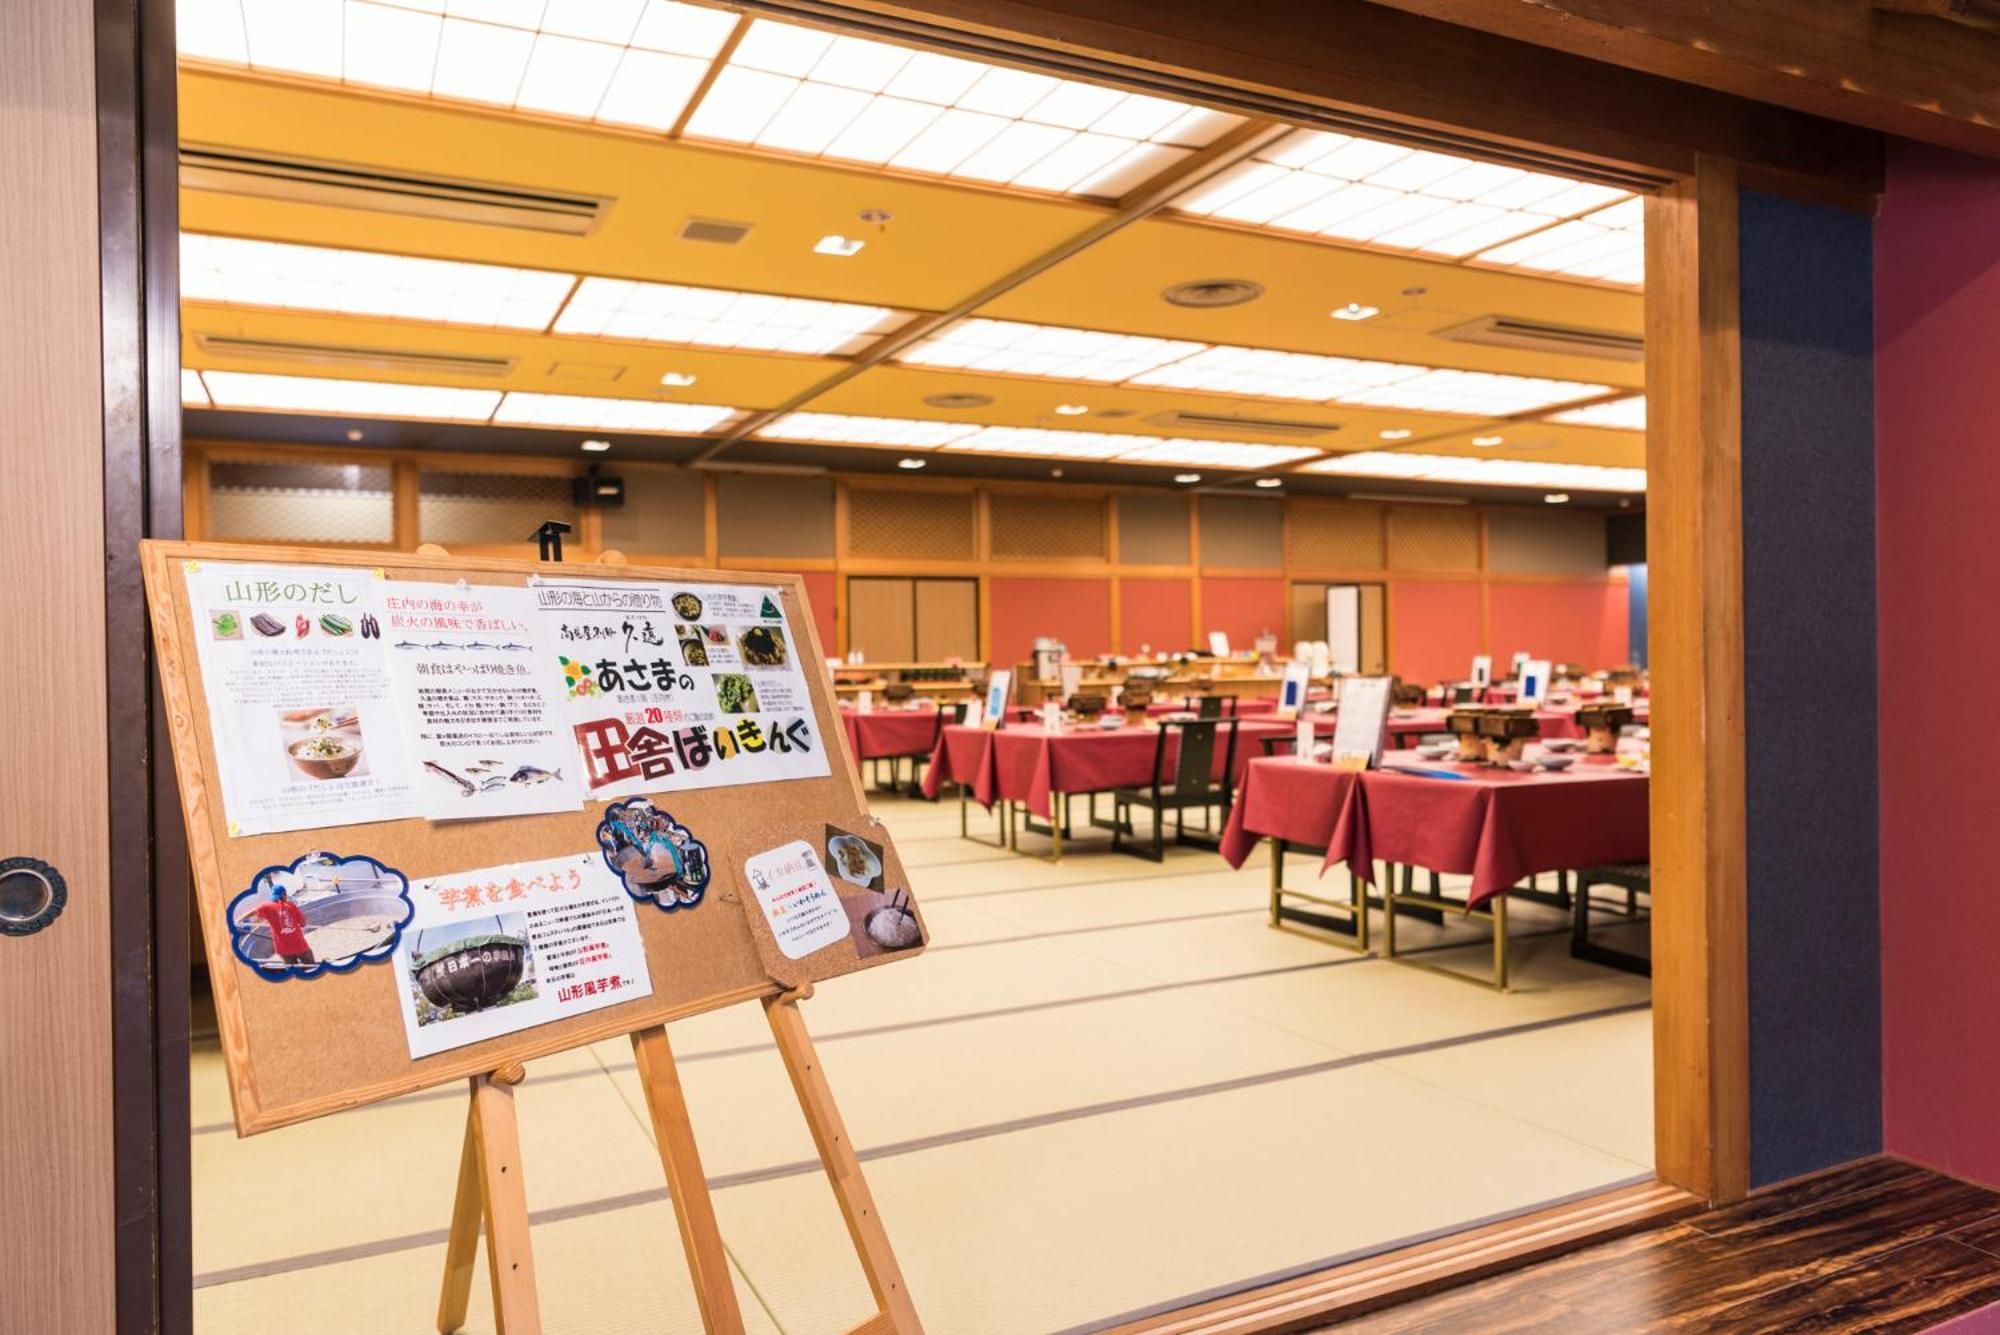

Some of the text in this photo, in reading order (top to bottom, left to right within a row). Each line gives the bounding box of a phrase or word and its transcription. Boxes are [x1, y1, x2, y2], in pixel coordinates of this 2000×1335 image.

[225, 580, 358, 604] 山形のだし
[595, 658, 695, 692] あさまの
[572, 717, 811, 790] 田舎ばいきんぐ
[438, 868, 582, 911] 芋煮を食べよう
